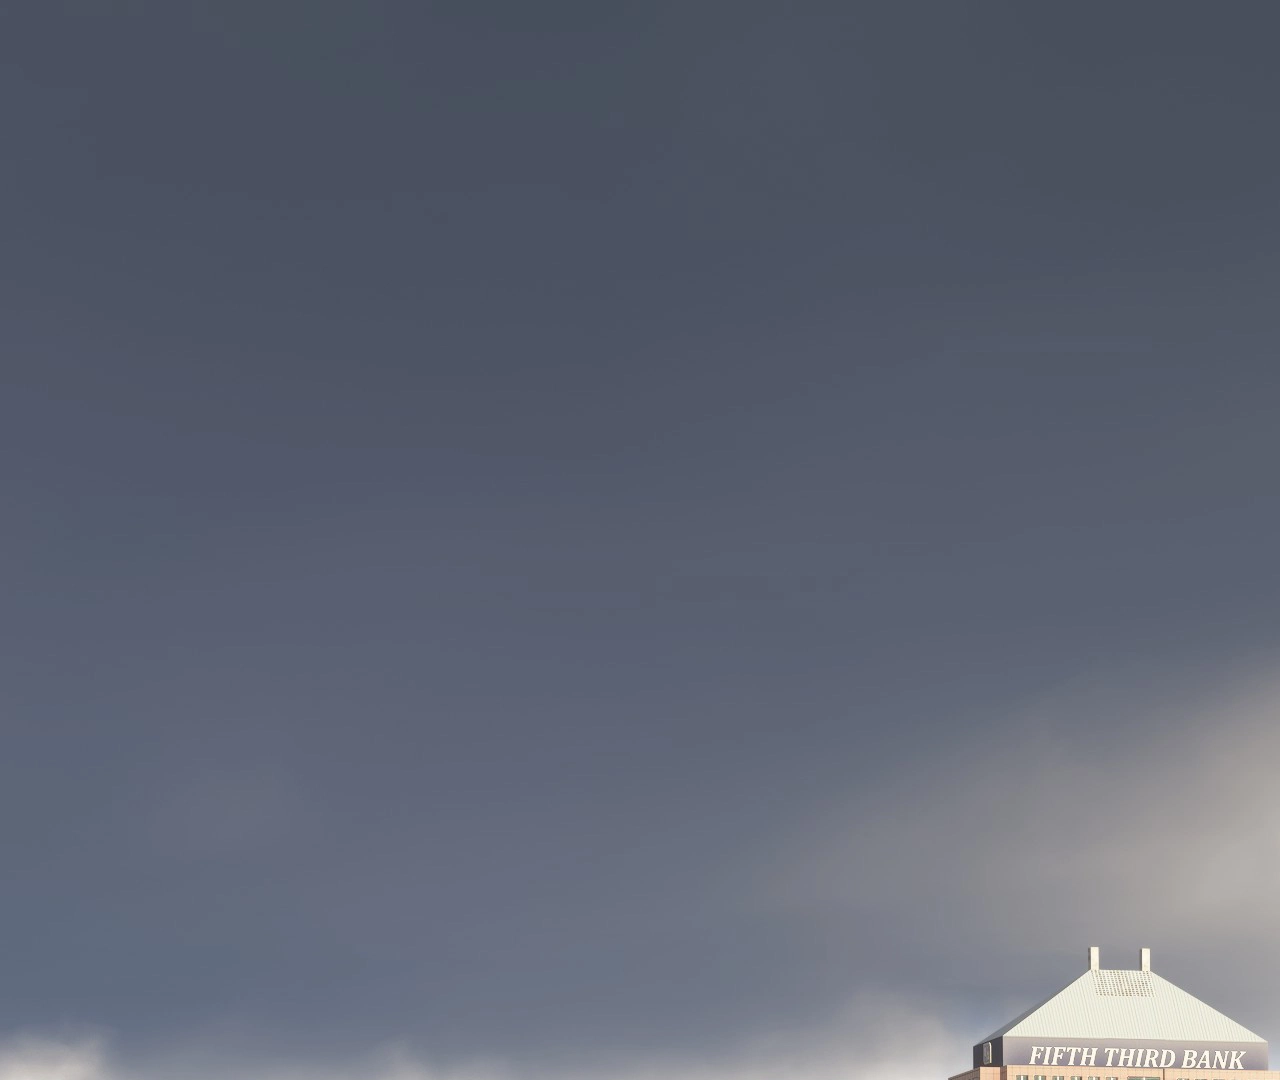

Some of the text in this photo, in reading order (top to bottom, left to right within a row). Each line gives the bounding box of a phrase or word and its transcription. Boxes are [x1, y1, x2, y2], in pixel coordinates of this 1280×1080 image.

[1028, 1046, 1247, 1070] FIFTH THIRD BANK
